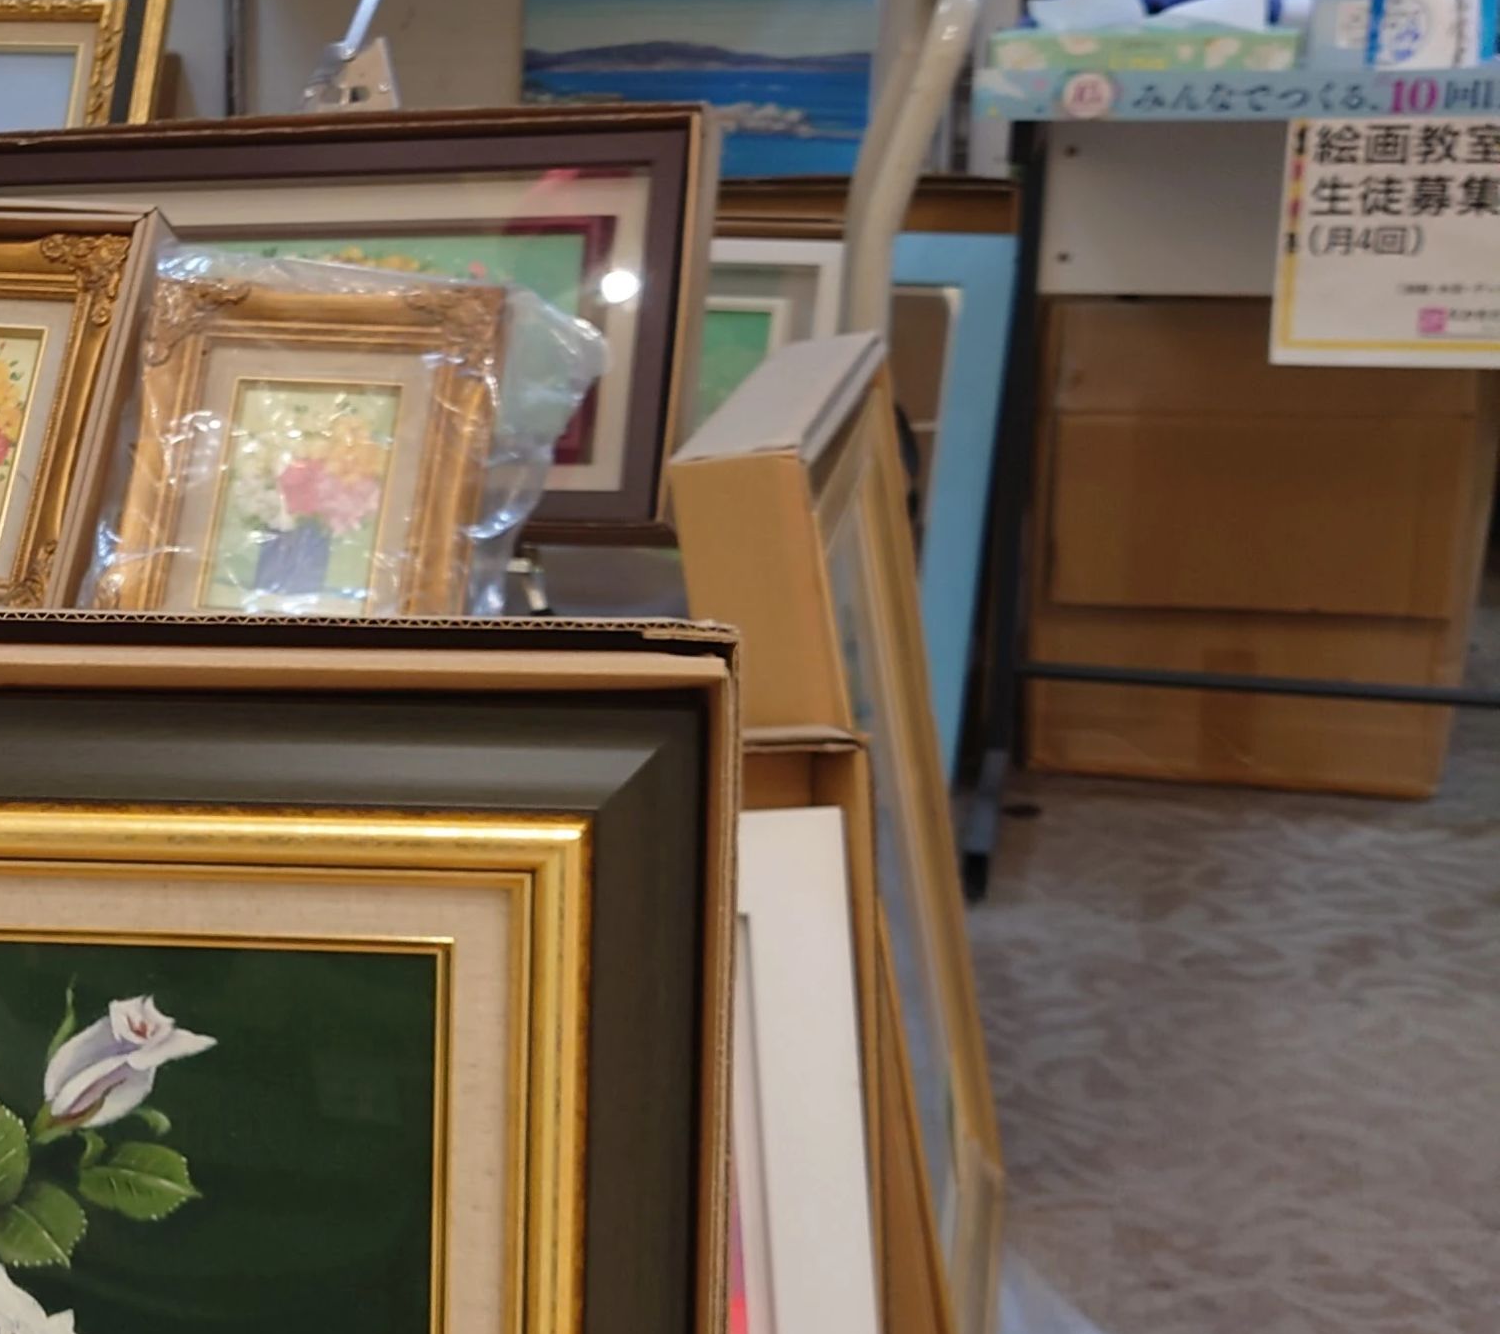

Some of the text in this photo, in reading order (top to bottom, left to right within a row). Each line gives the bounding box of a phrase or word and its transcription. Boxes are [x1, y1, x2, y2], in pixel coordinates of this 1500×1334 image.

[1313, 122, 1500, 165] 絵画教室
[1308, 173, 1500, 216] 生徒募集
[1308, 223, 1424, 258] (月4回)
